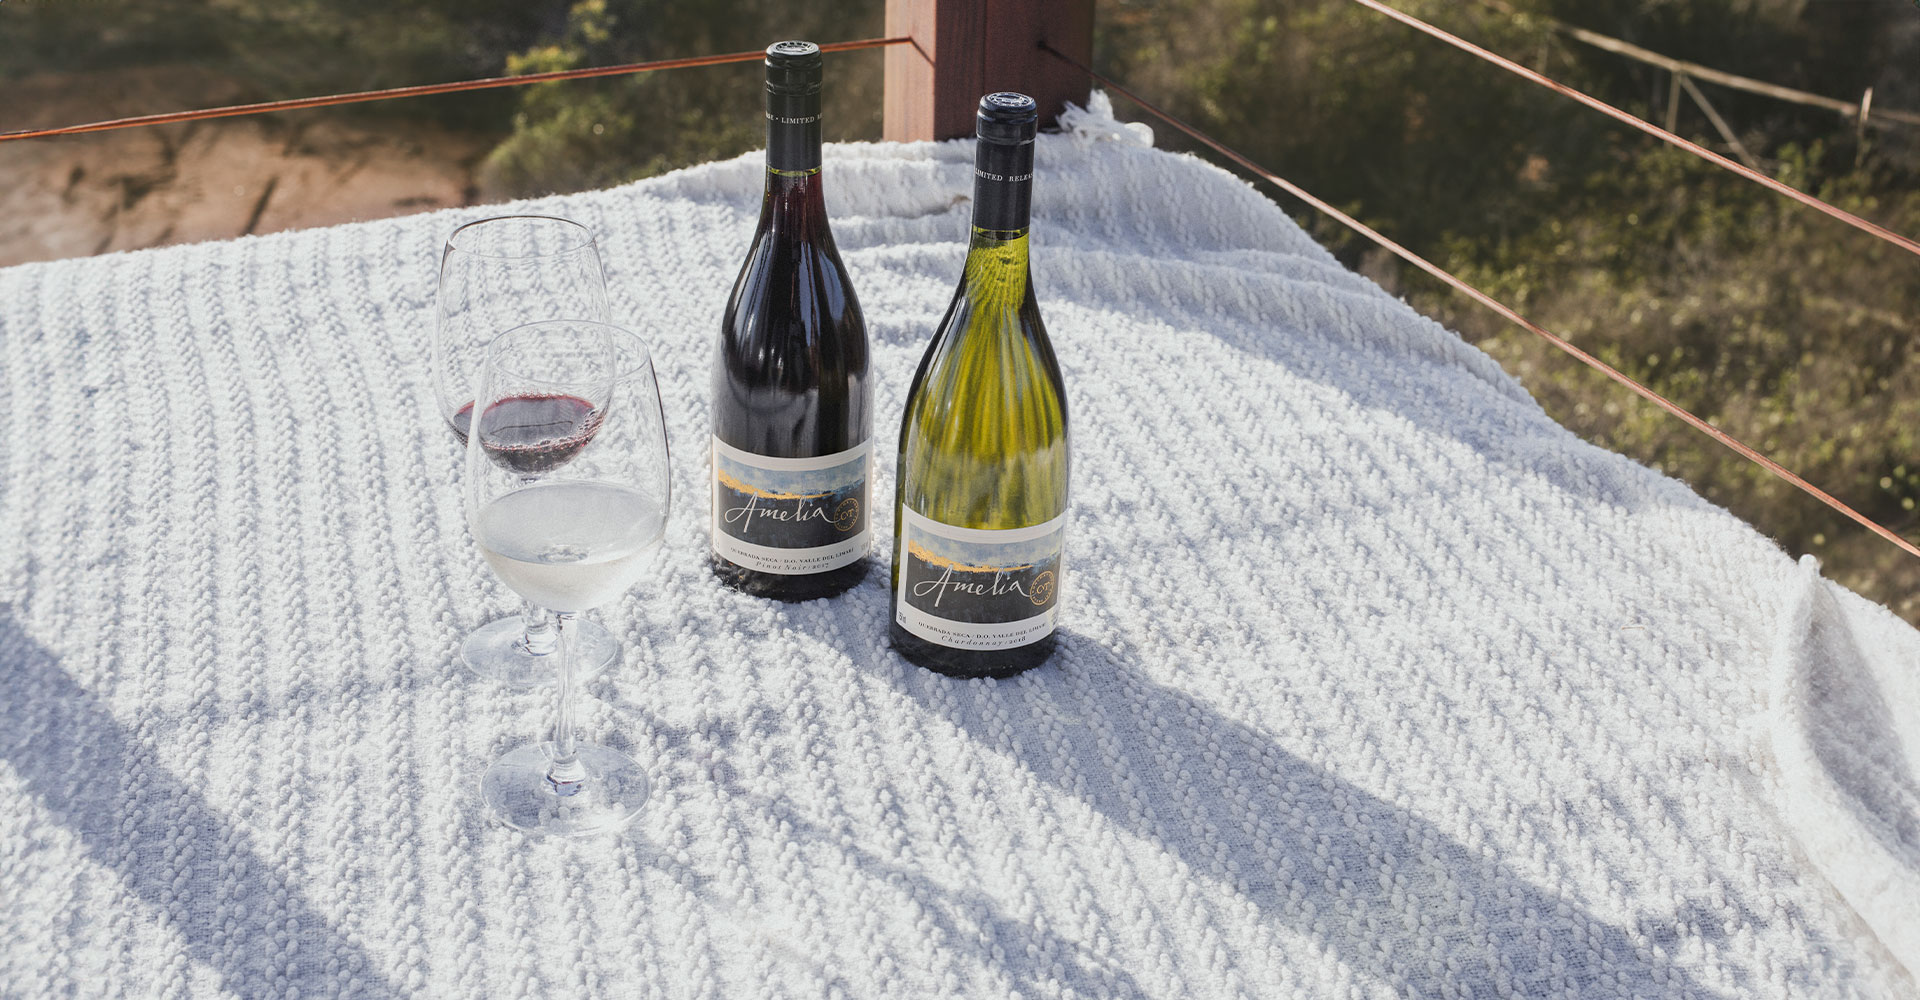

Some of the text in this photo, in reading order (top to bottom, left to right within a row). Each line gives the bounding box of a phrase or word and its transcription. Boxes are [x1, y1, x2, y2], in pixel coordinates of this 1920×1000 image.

[781, 116, 815, 124] LIMITED
[724, 490, 840, 533] Amelia
[755, 560, 781, 569] Pinot
[913, 563, 1036, 607] Amelia
